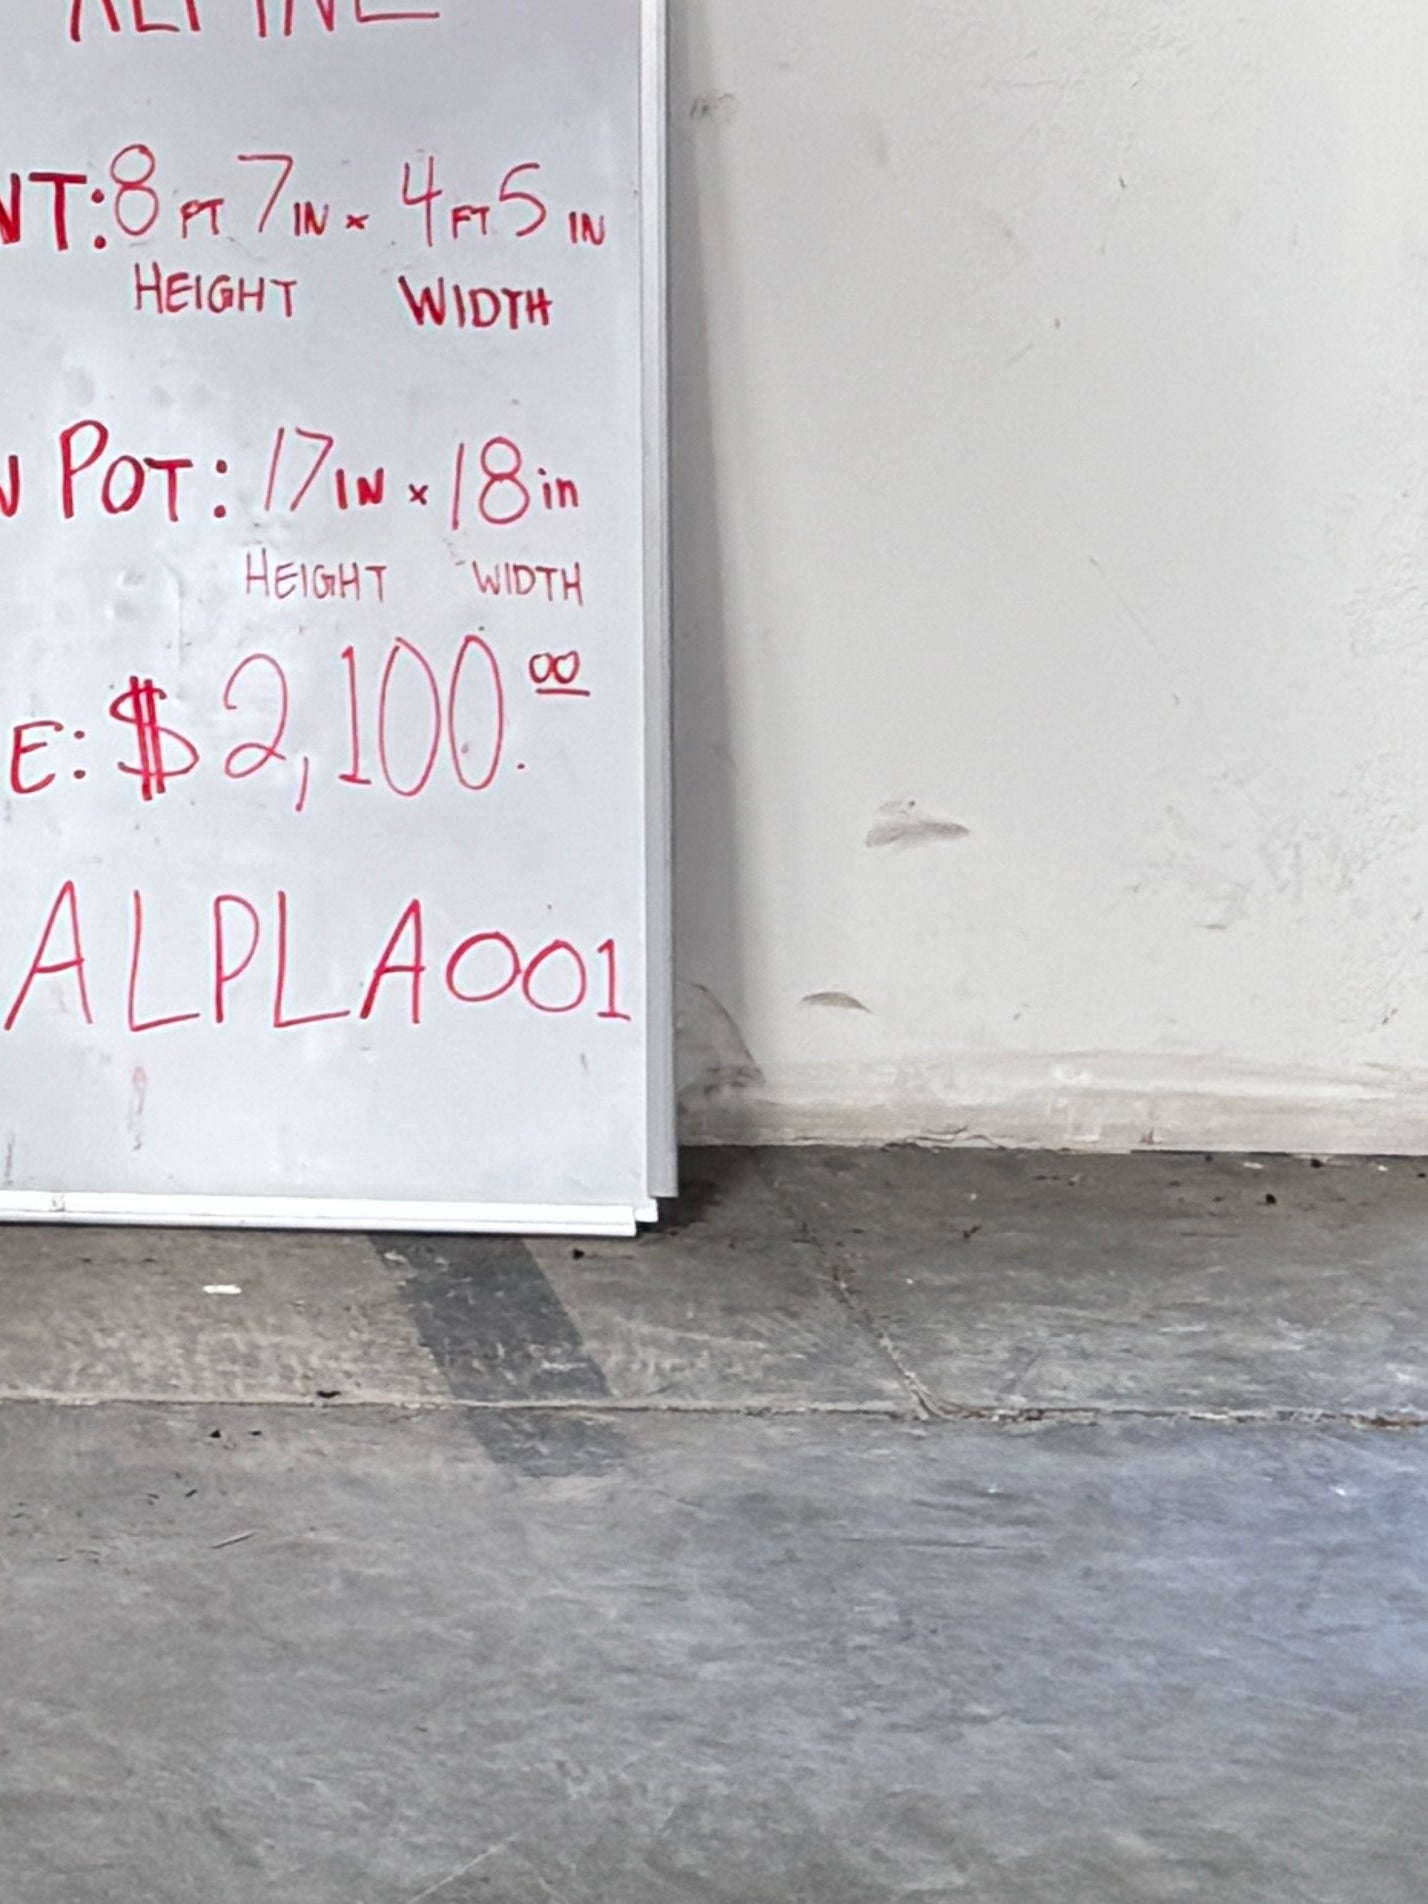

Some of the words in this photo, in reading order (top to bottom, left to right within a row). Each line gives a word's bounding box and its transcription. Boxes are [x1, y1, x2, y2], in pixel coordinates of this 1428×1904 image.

[134, 264, 295, 317] HEIGHT
[398, 279, 551, 330] WIDTH
[245, 547, 389, 602] HEIGHT
[472, 560, 584, 607] WIDTH
